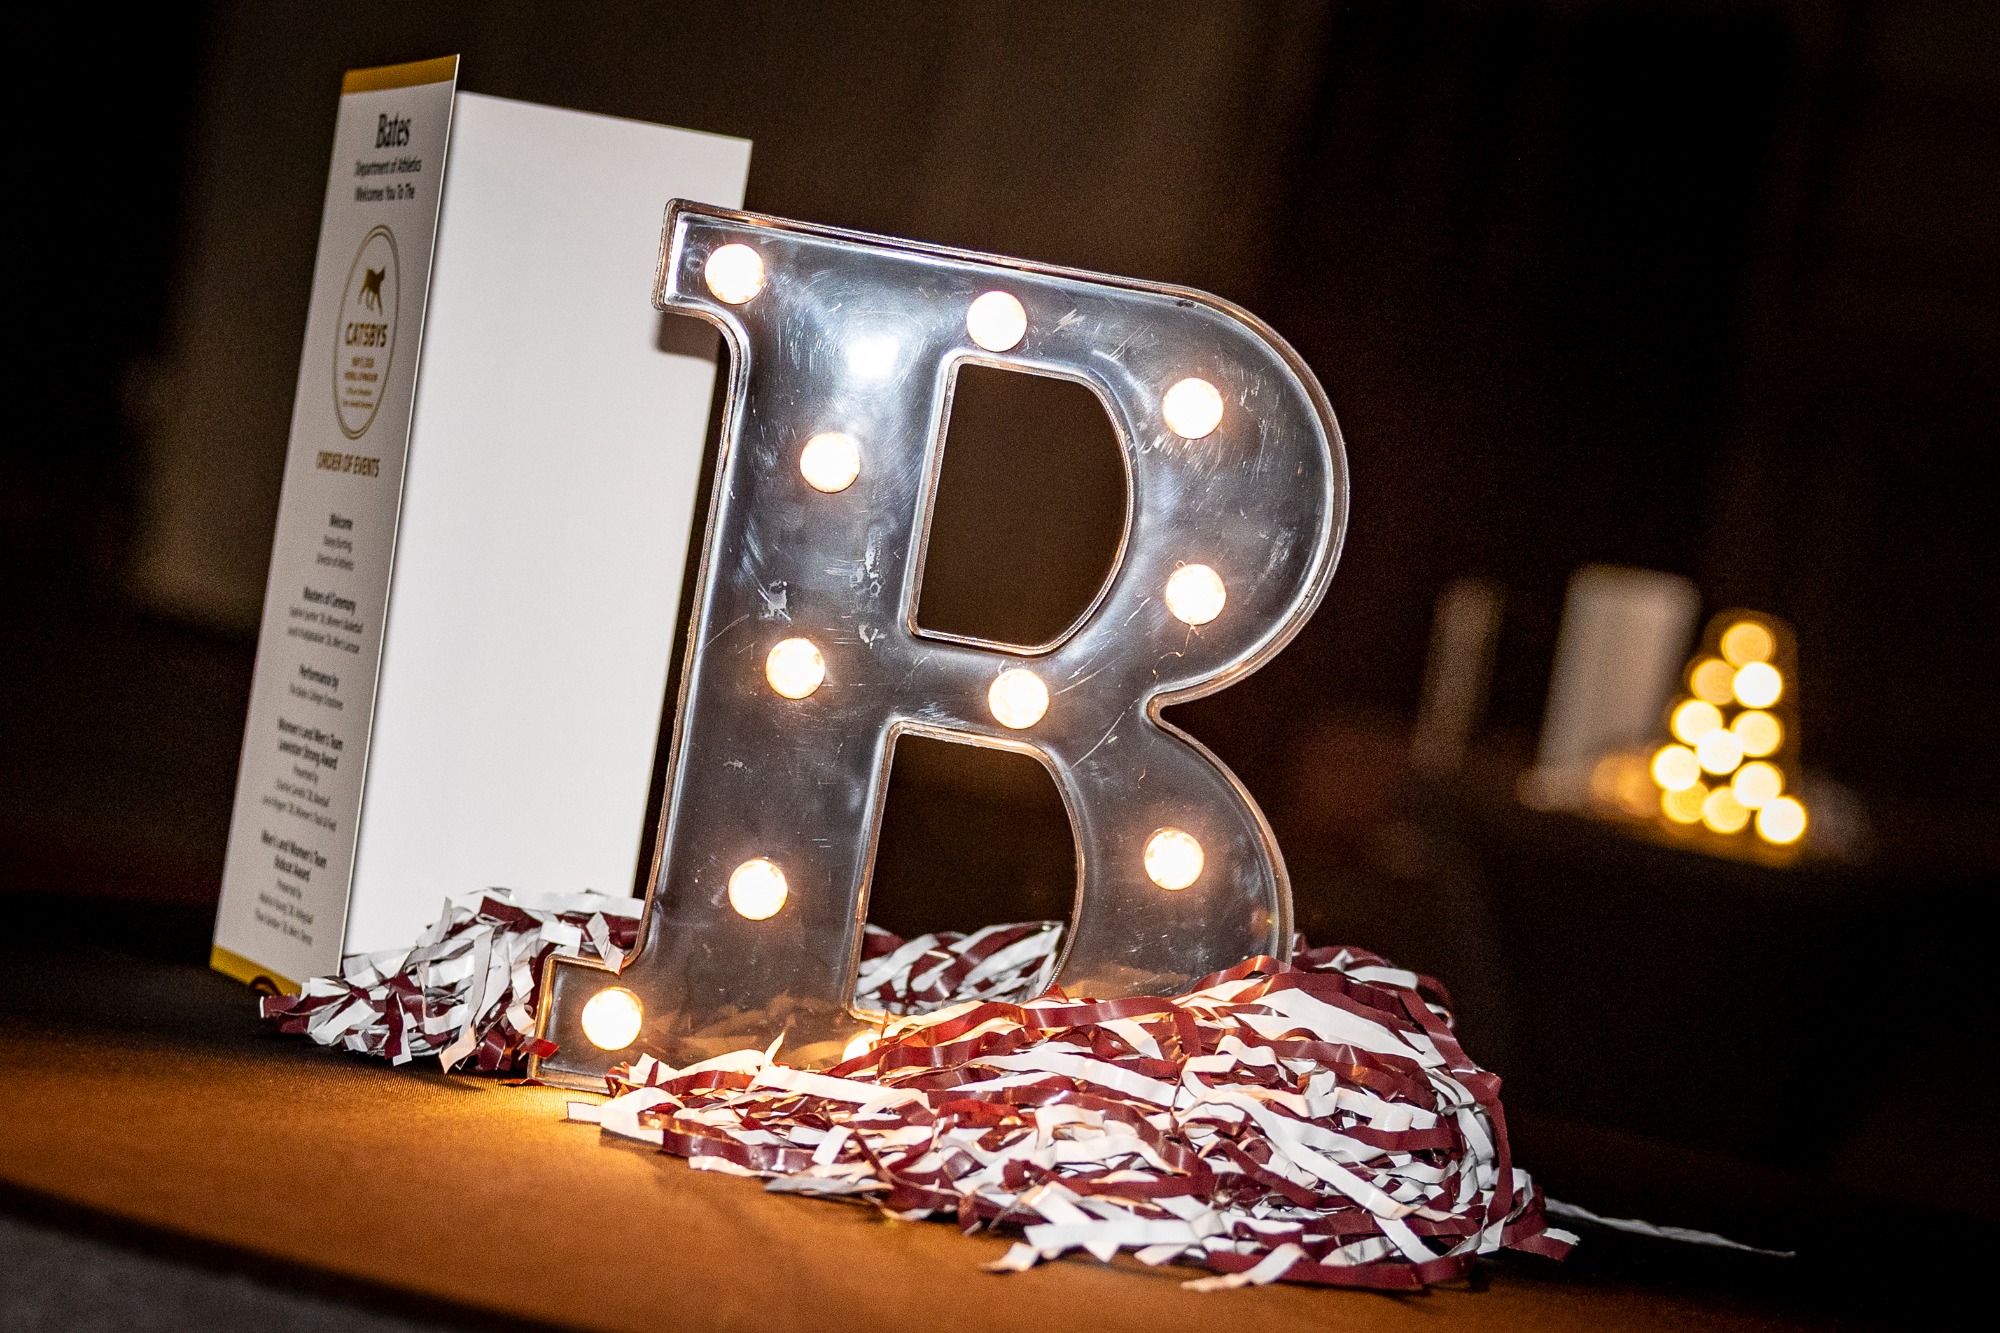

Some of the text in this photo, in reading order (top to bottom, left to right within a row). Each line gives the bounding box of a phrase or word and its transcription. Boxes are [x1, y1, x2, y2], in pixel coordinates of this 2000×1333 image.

[375, 112, 411, 148] Bates
[354, 158, 389, 179] Department
[398, 155, 422, 173] Athletics
[354, 182, 415, 201] Welcomes You To The
[345, 322, 388, 347] CATSBYS
[316, 451, 380, 478] ORDER OF EVENTS
